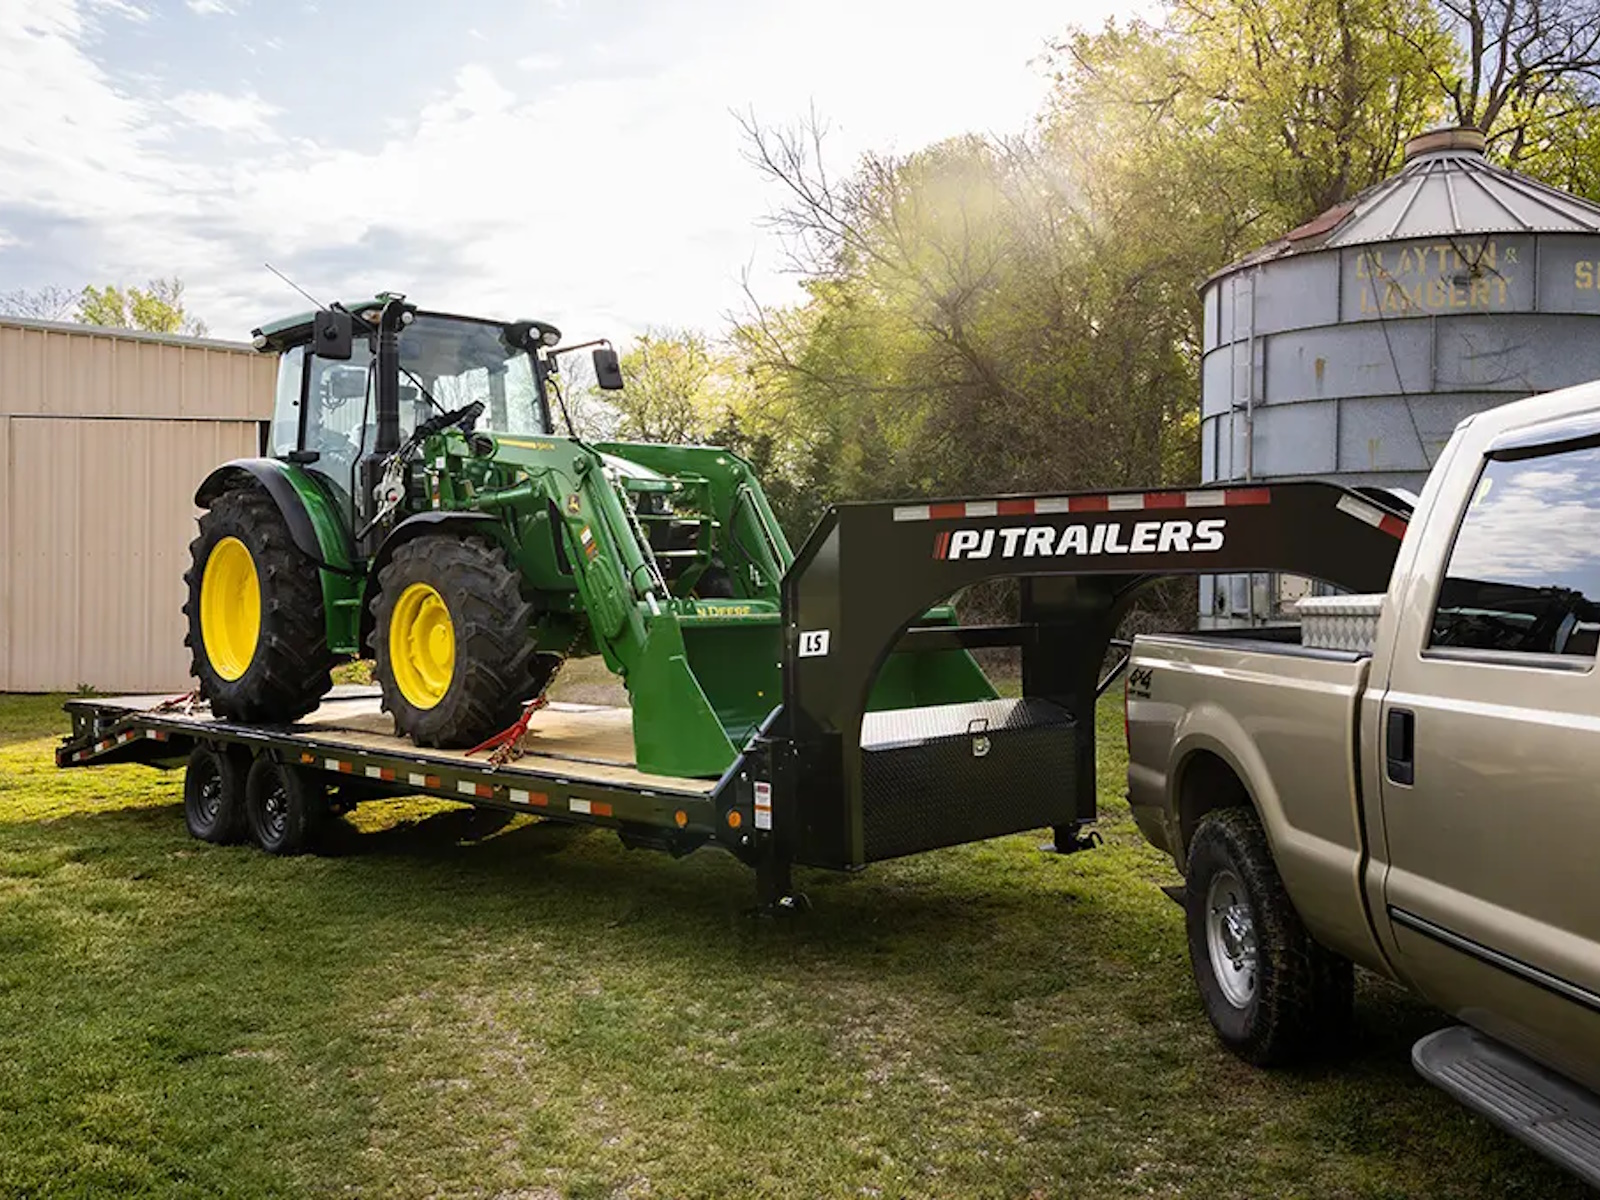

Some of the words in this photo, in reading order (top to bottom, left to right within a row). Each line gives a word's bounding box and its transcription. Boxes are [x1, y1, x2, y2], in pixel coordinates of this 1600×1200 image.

[1575, 260, 1600, 290] S
[1000, 519, 1226, 558] TRAILERS
[806, 634, 822, 652] LS
